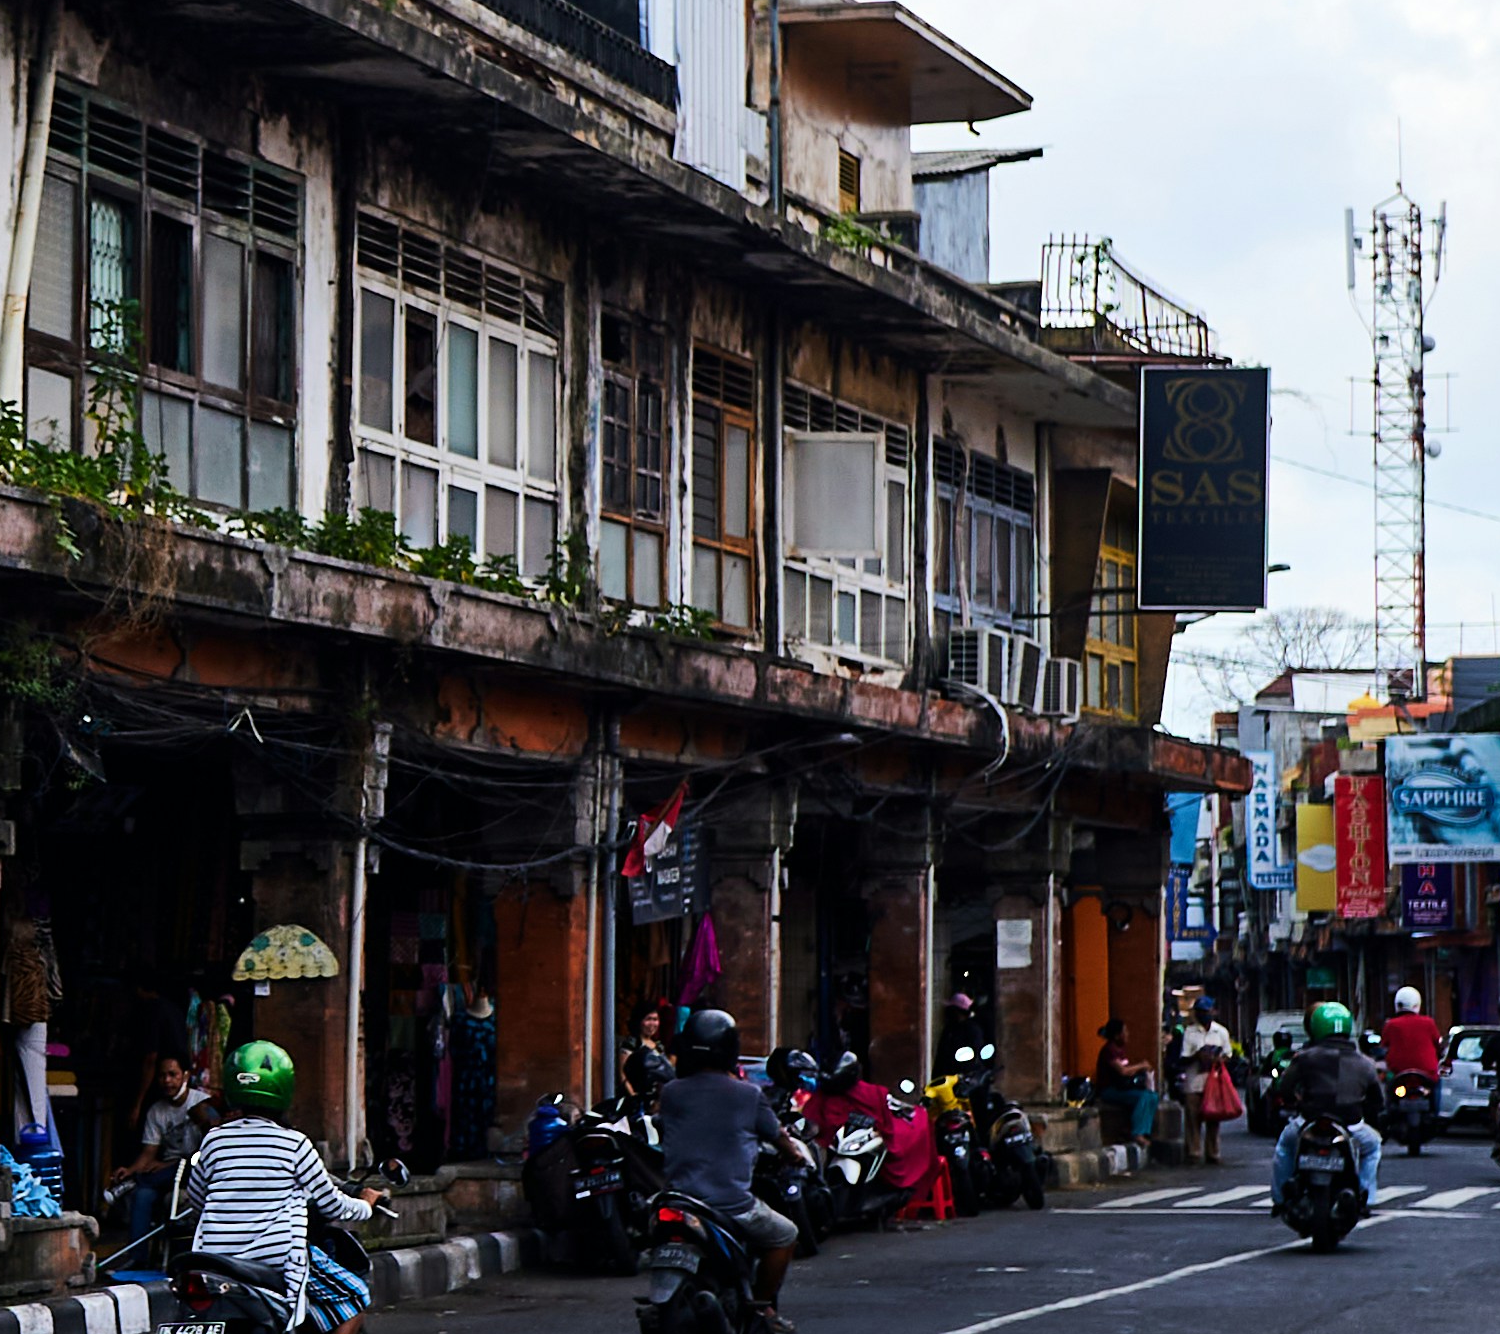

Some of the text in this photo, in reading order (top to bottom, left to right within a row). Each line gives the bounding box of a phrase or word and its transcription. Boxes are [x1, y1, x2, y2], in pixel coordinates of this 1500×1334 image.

[1151, 469, 1262, 507] SAS
[1255, 763, 1271, 862] NARMADA
[1400, 789, 1486, 807] SAPPHIRE
